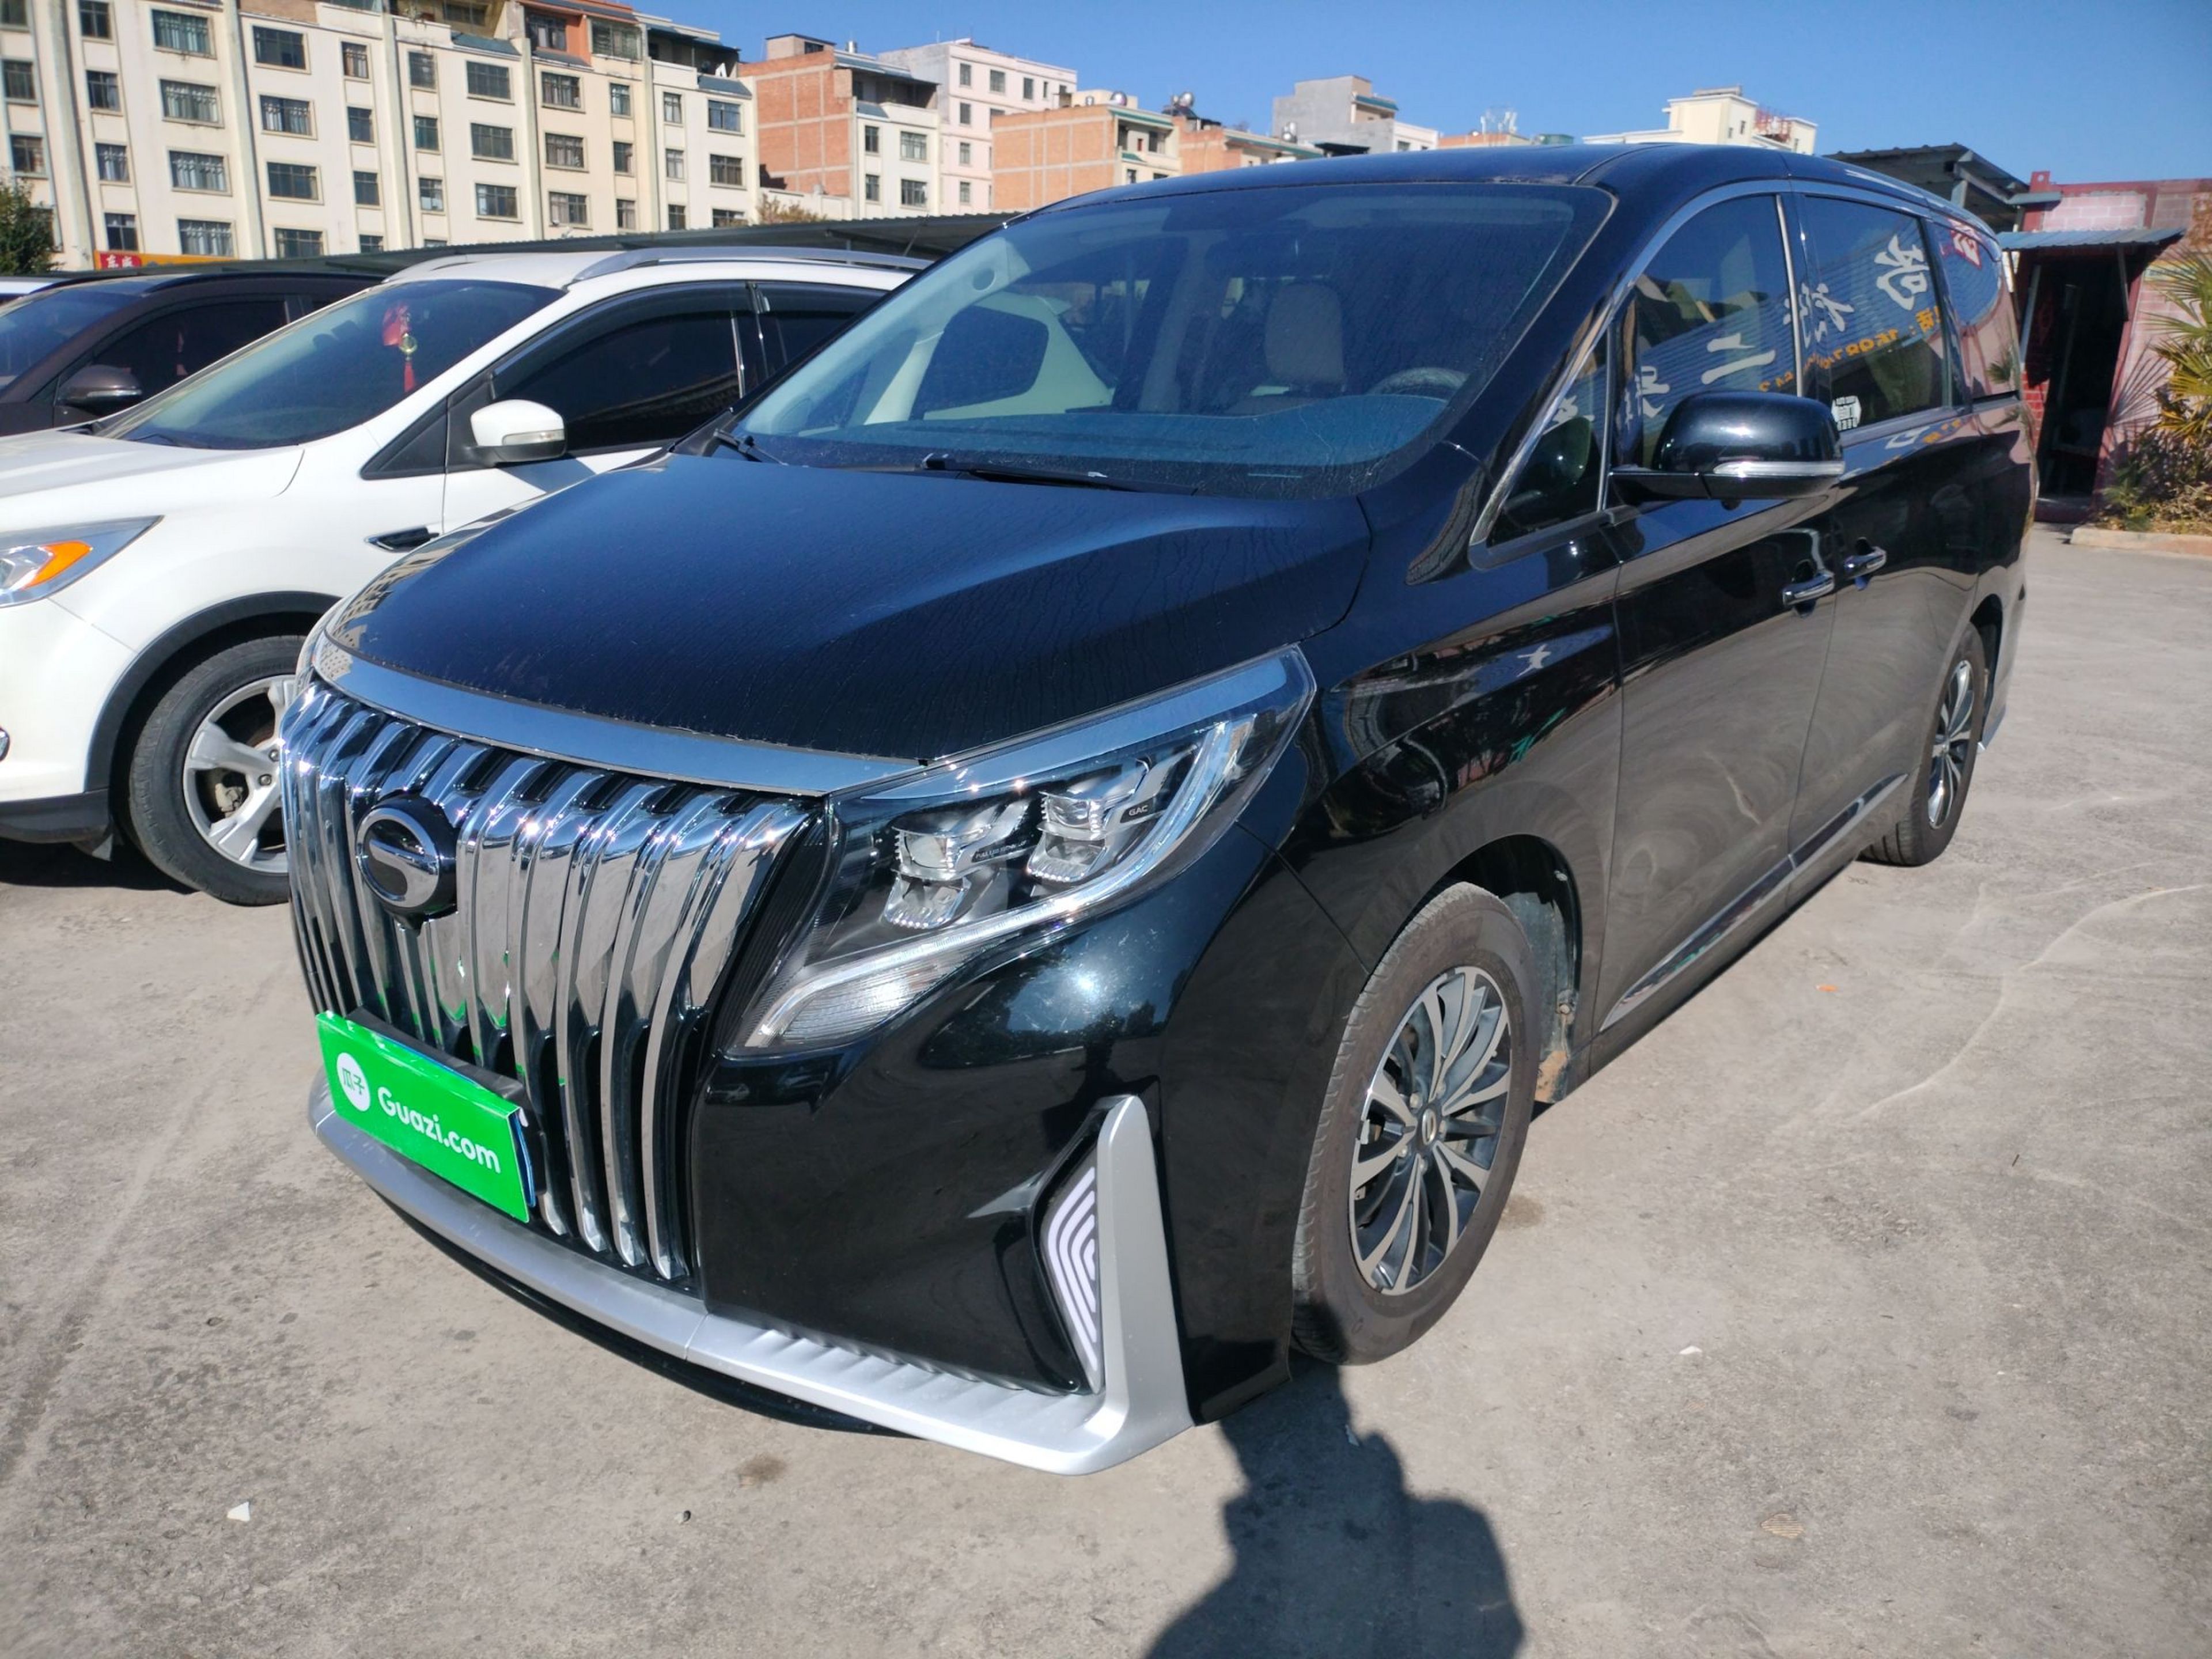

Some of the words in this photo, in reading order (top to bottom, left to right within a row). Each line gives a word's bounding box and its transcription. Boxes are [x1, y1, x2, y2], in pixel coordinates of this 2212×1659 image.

[1128, 805, 1148, 816] GAC
[342, 1067, 365, 1095] 瓜子
[377, 1086, 501, 1174] Guazi.com
